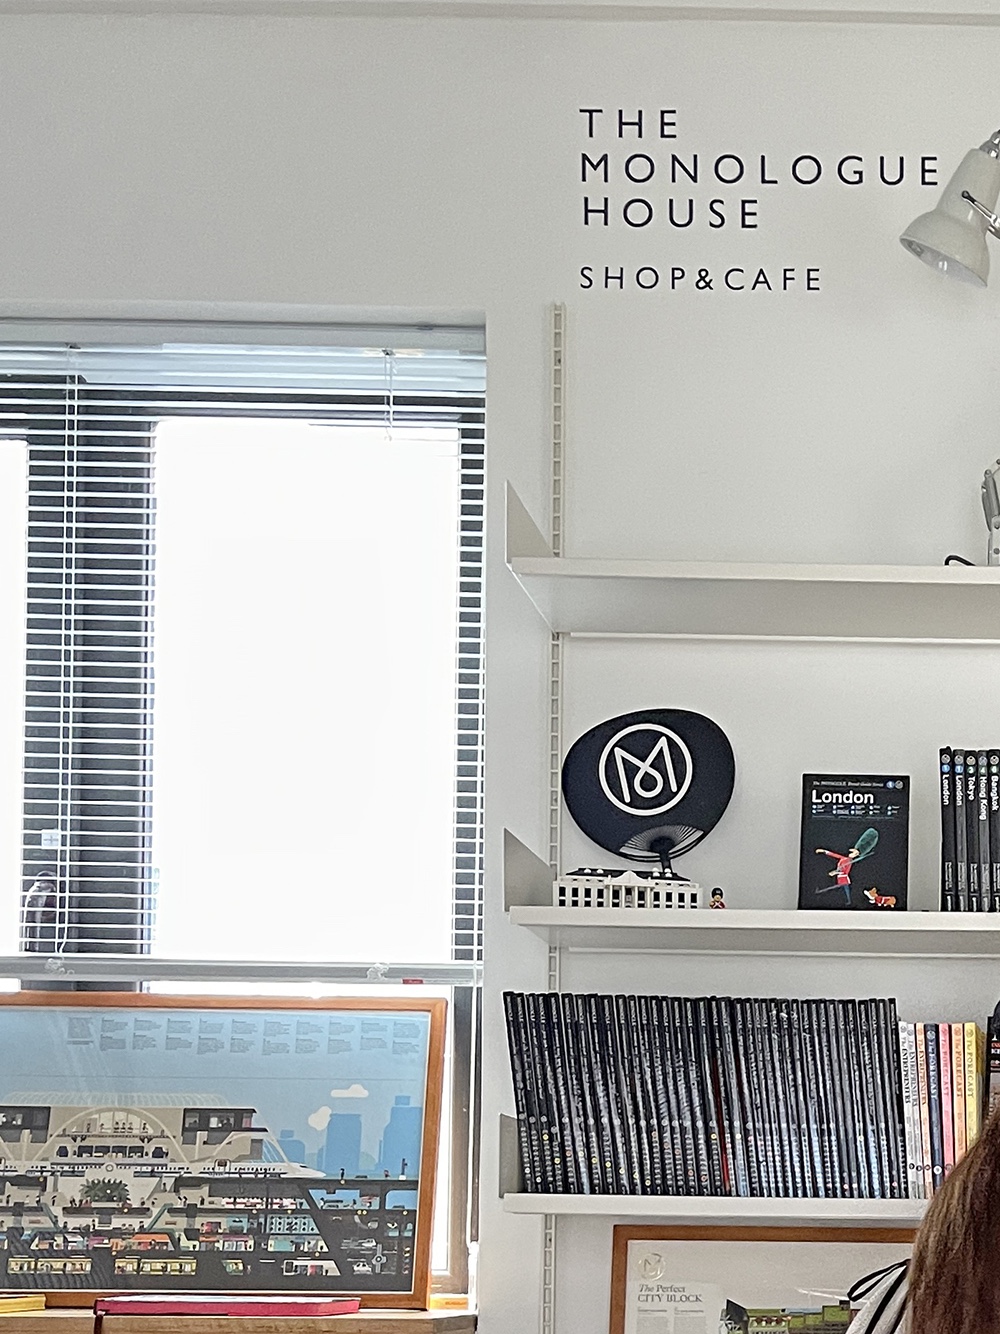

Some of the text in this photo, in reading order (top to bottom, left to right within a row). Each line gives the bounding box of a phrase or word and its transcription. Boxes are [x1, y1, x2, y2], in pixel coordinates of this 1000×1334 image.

[579, 108, 678, 138] THE
[581, 153, 939, 186] MONOLOGUE
[583, 197, 758, 229] HOUSE
[580, 266, 821, 291] SHOP&CAFE
[811, 789, 874, 804] London
[637, 1294, 703, 1303] CITY BLOCK
[639, 1284, 686, 1293] The Perfect
